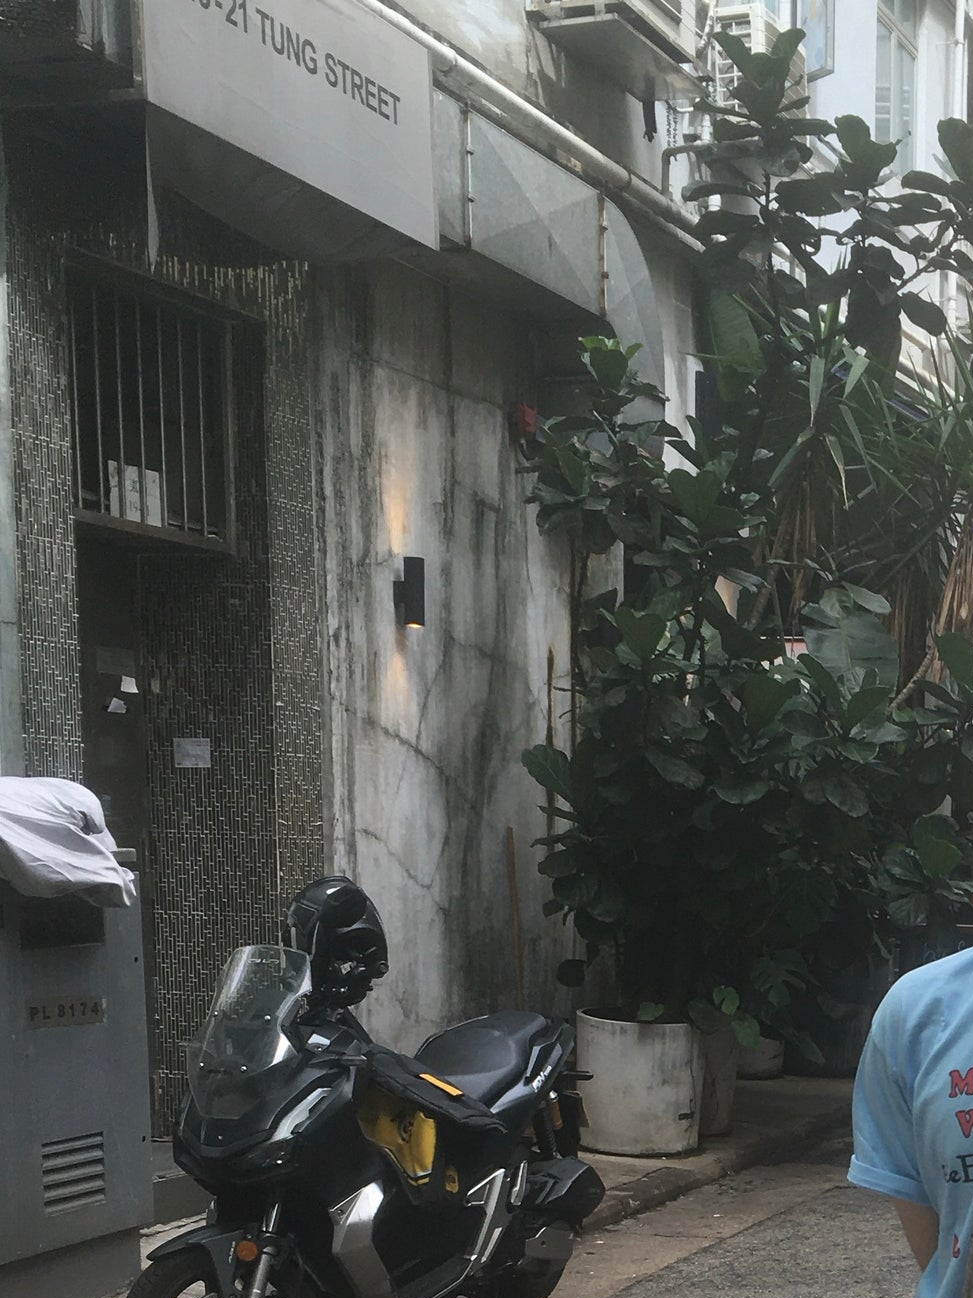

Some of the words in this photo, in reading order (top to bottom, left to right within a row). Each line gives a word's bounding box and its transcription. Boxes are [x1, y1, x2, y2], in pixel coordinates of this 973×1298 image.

[255, 7, 318, 75] TUNG
[325, 53, 400, 125] STREET
[30, 1005, 51, 1021] PL
[58, 1002, 100, 1018] 8174
